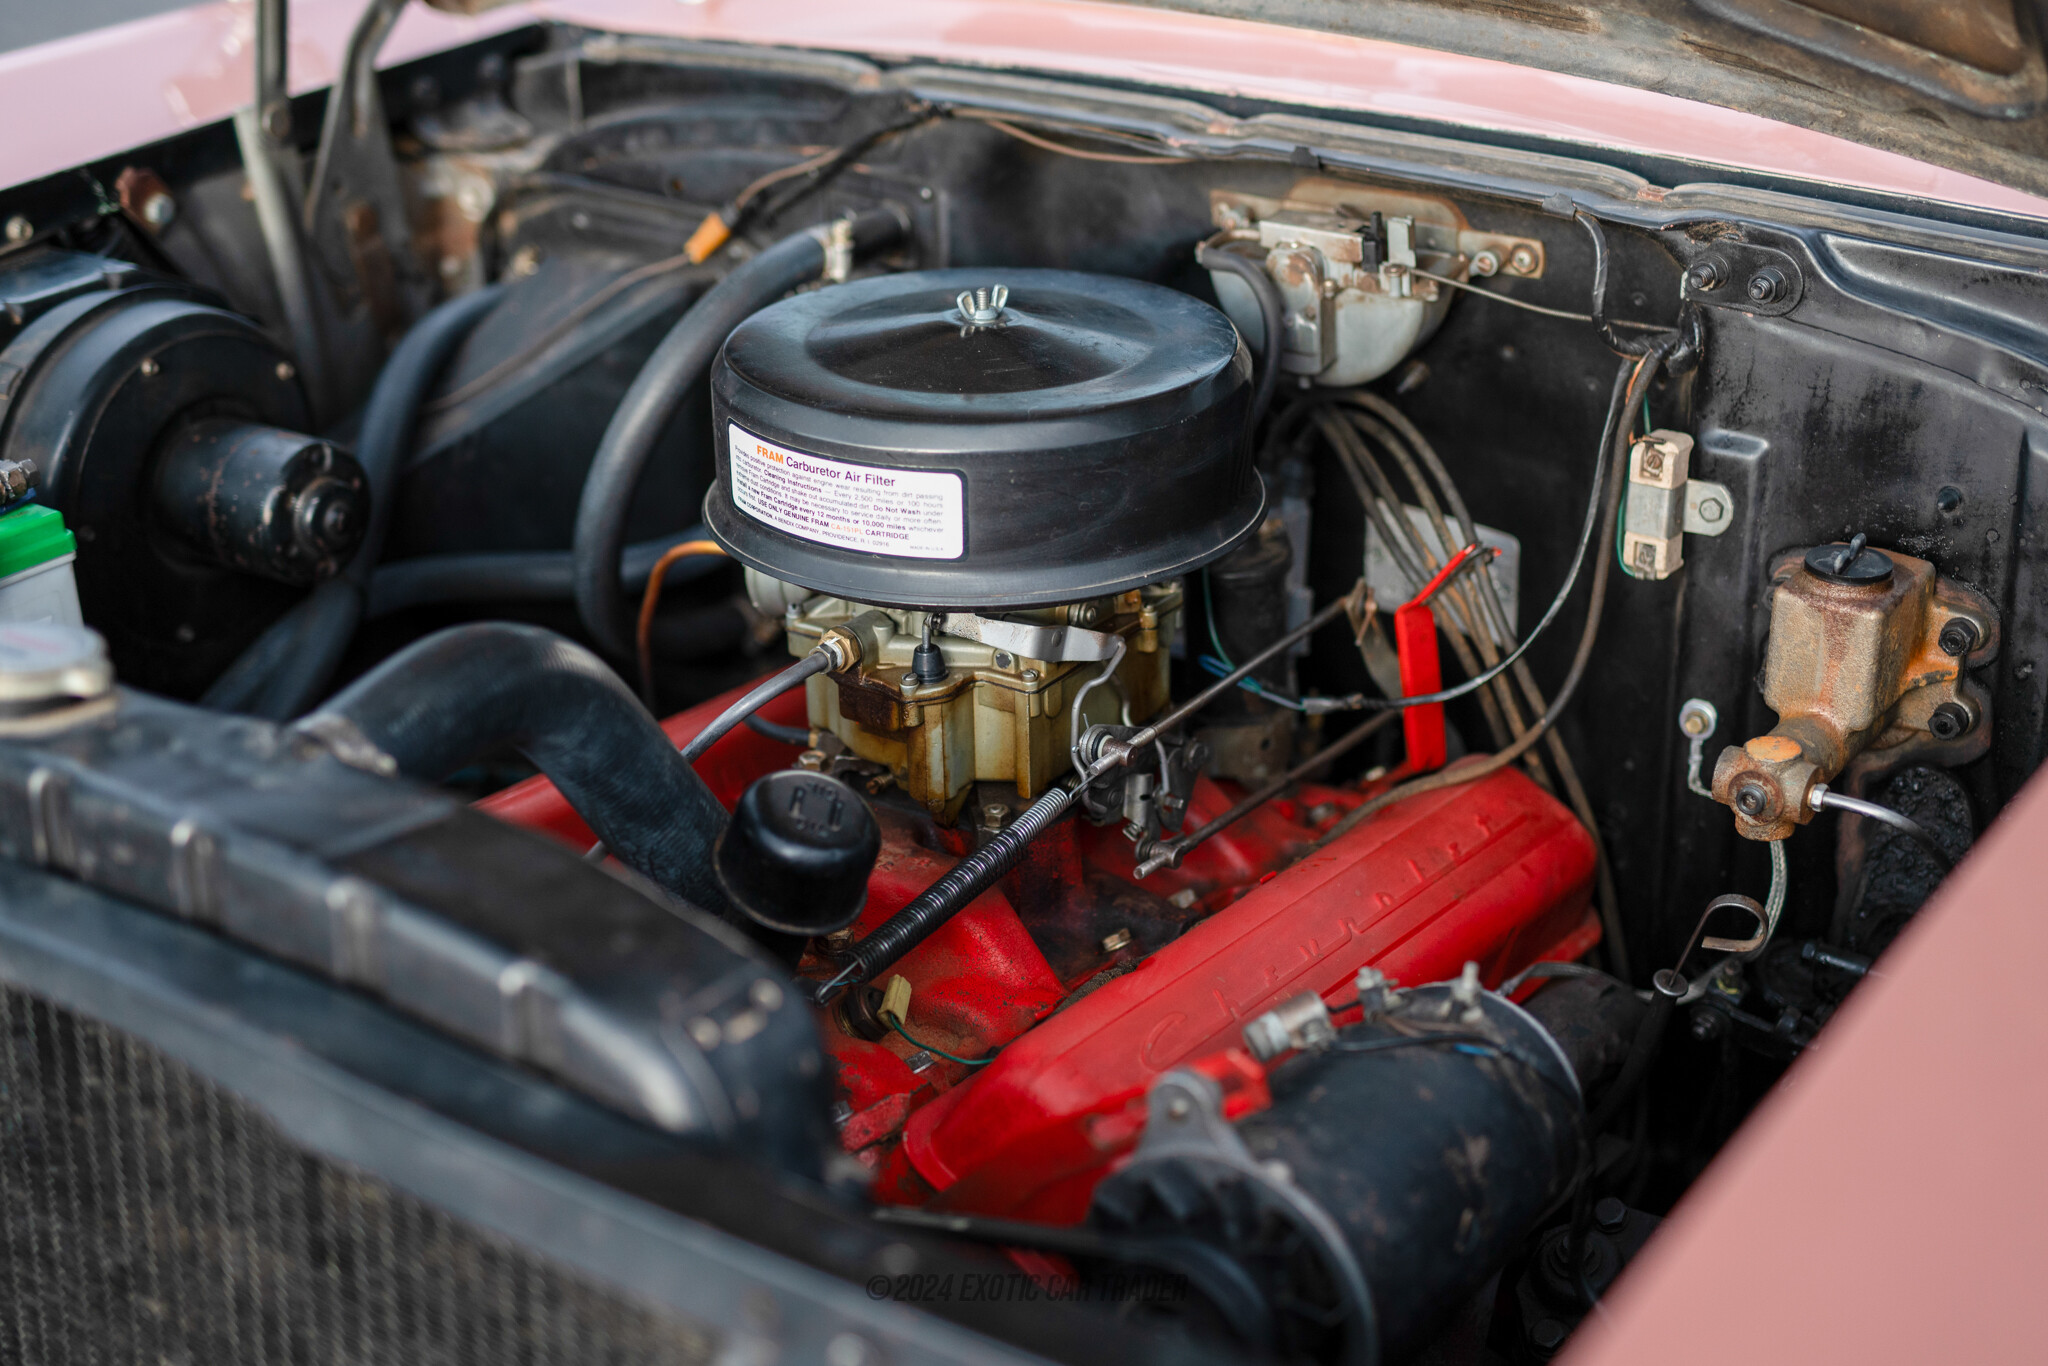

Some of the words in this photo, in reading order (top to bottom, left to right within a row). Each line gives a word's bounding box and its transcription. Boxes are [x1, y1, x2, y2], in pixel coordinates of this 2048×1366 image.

[750, 456, 765, 467] positive
[767, 464, 790, 476] protection
[792, 473, 811, 482] against
[853, 487, 880, 496] resulting
[756, 445, 784, 464] FRAM
[786, 456, 840, 478] Carburetor
[845, 470, 861, 482] Air
[865, 473, 896, 486] Filter
[749, 470, 759, 479] Fram
[760, 475, 780, 488] Cartridge
[792, 488, 807, 497] shake
[820, 496, 857, 508] accumulated
[764, 469, 785, 484] Cleaning
[788, 479, 822, 492] Instructions
[834, 490, 851, 499] Every
[758, 498, 767, 507] USE
[768, 503, 782, 513] ONLY
[784, 509, 809, 522] GENUINE
[811, 518, 829, 527] FRAM
[865, 529, 909, 540] CARTRIDGE
[761, 491, 772, 501] Fram
[774, 497, 798, 510] Cartridge
[799, 507, 815, 516] every
[826, 514, 850, 523] months
[778, 516, 794, 526] BENDIX
[790, 496, 800, 504] may
[811, 502, 840, 514] necessary
